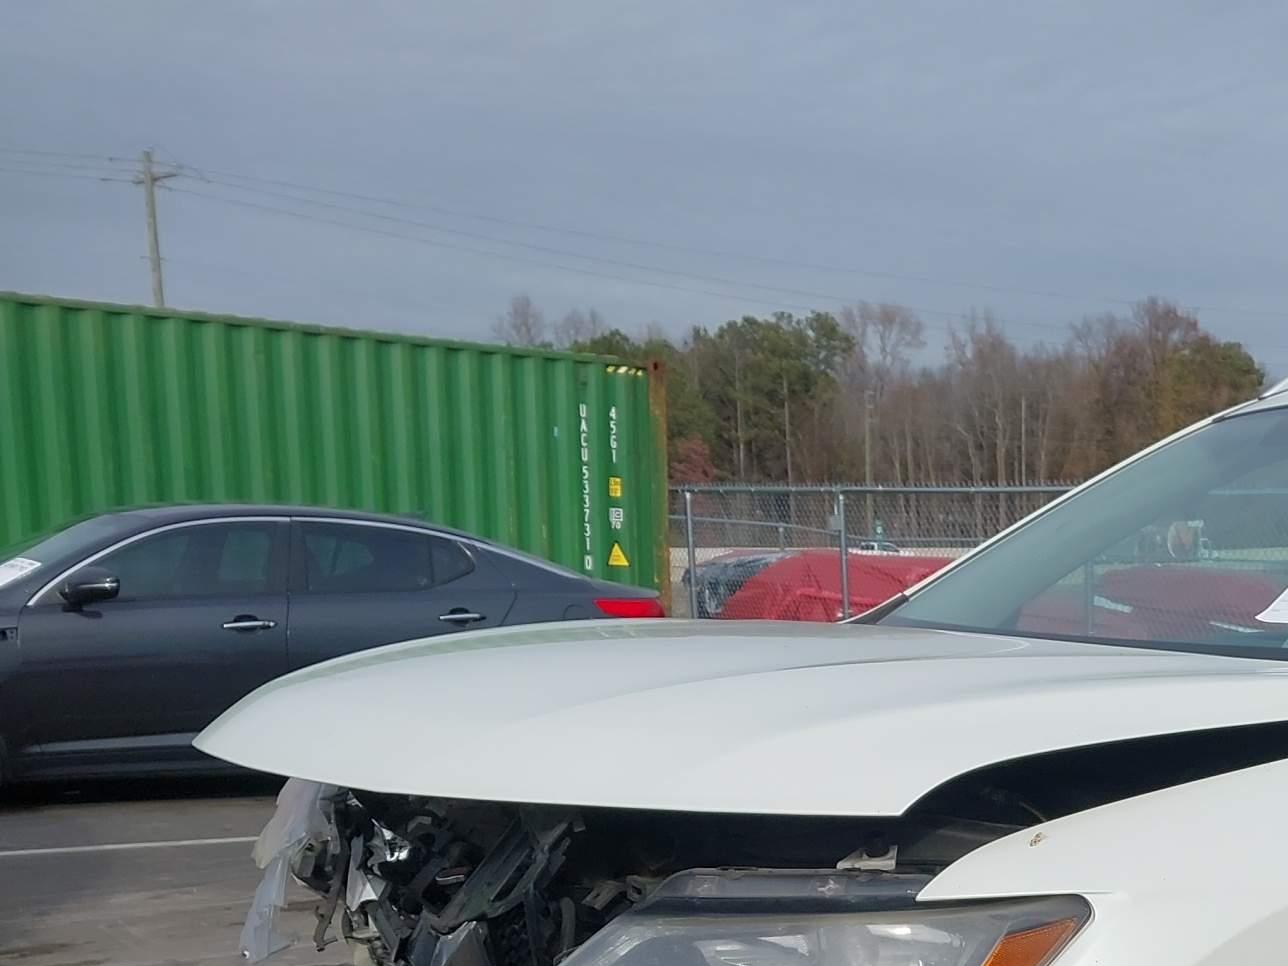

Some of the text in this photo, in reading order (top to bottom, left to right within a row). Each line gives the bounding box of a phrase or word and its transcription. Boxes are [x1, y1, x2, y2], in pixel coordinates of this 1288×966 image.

[579, 404, 589, 461] UACU
[608, 406, 617, 464] 45G1
[581, 465, 590, 551] 533731
